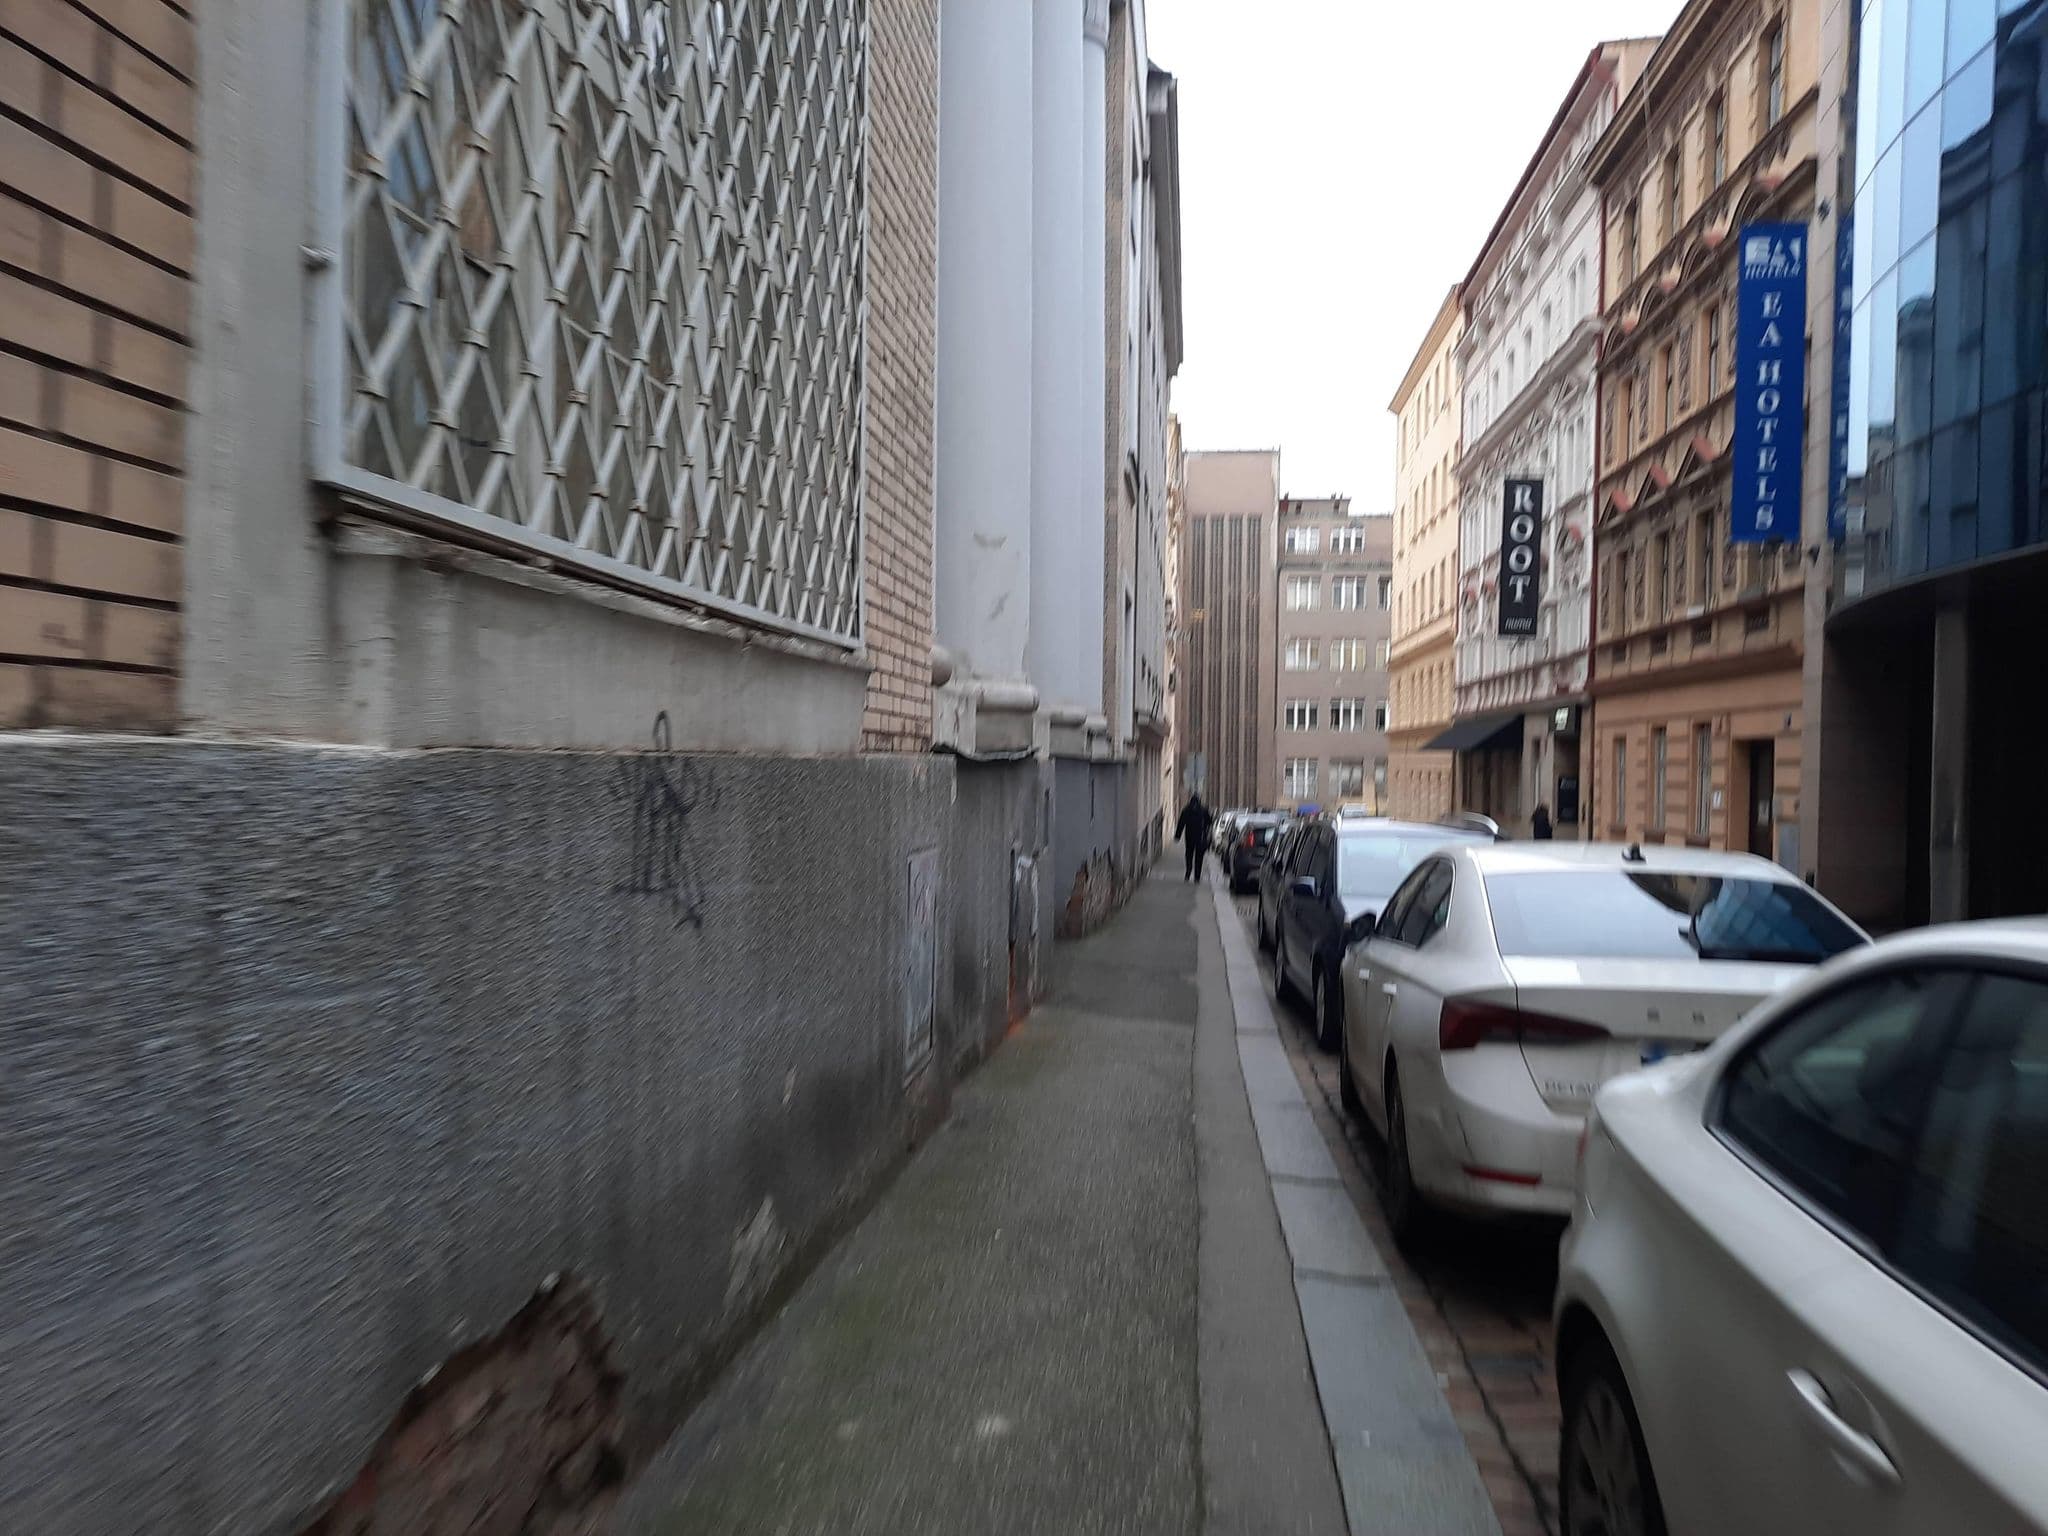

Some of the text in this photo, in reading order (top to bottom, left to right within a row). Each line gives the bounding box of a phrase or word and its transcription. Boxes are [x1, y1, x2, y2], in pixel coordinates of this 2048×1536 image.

[1755, 291, 1782, 531] EA HOTELS
[1509, 484, 1535, 604] ROOT
